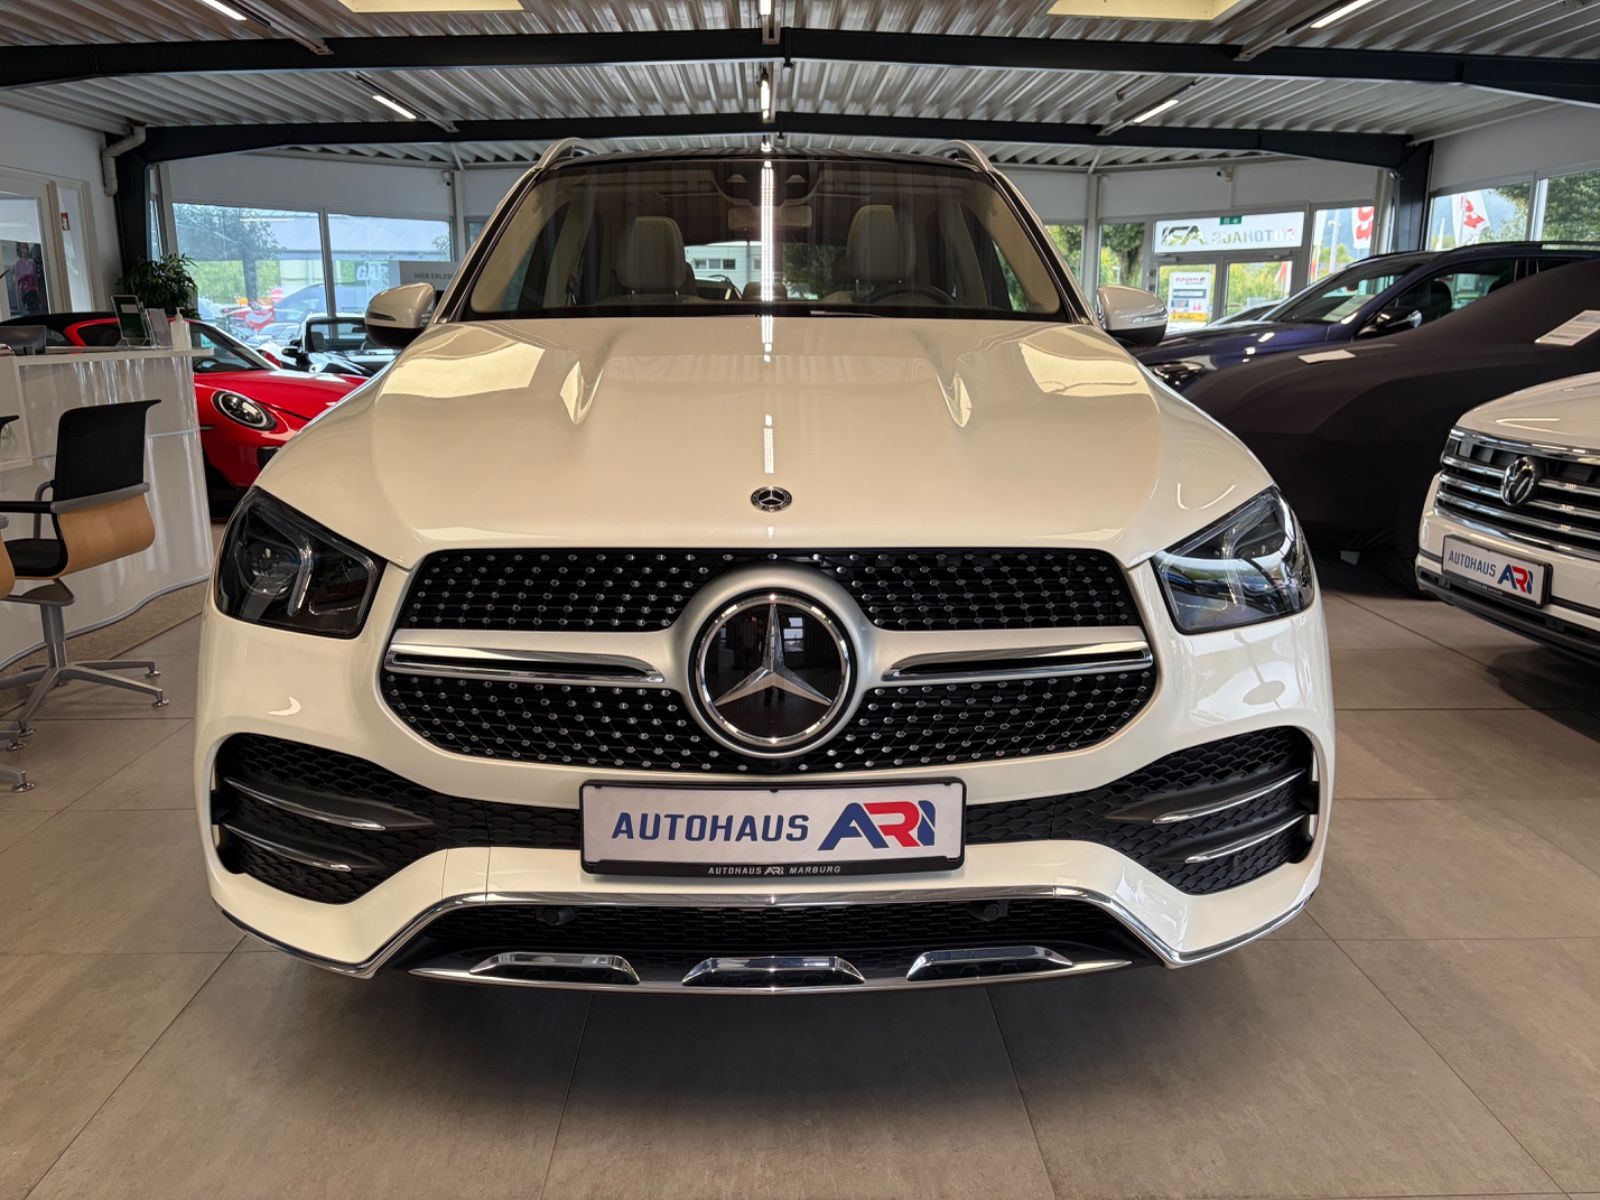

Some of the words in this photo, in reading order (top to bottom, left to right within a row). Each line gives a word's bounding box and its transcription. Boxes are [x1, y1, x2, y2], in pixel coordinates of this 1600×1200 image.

[1448, 550, 1497, 577] AUTOHAUS
[611, 812, 809, 842] AUTOHAUS
[708, 866, 762, 875] AUTOHAUS
[789, 865, 841, 874] MARBURG
